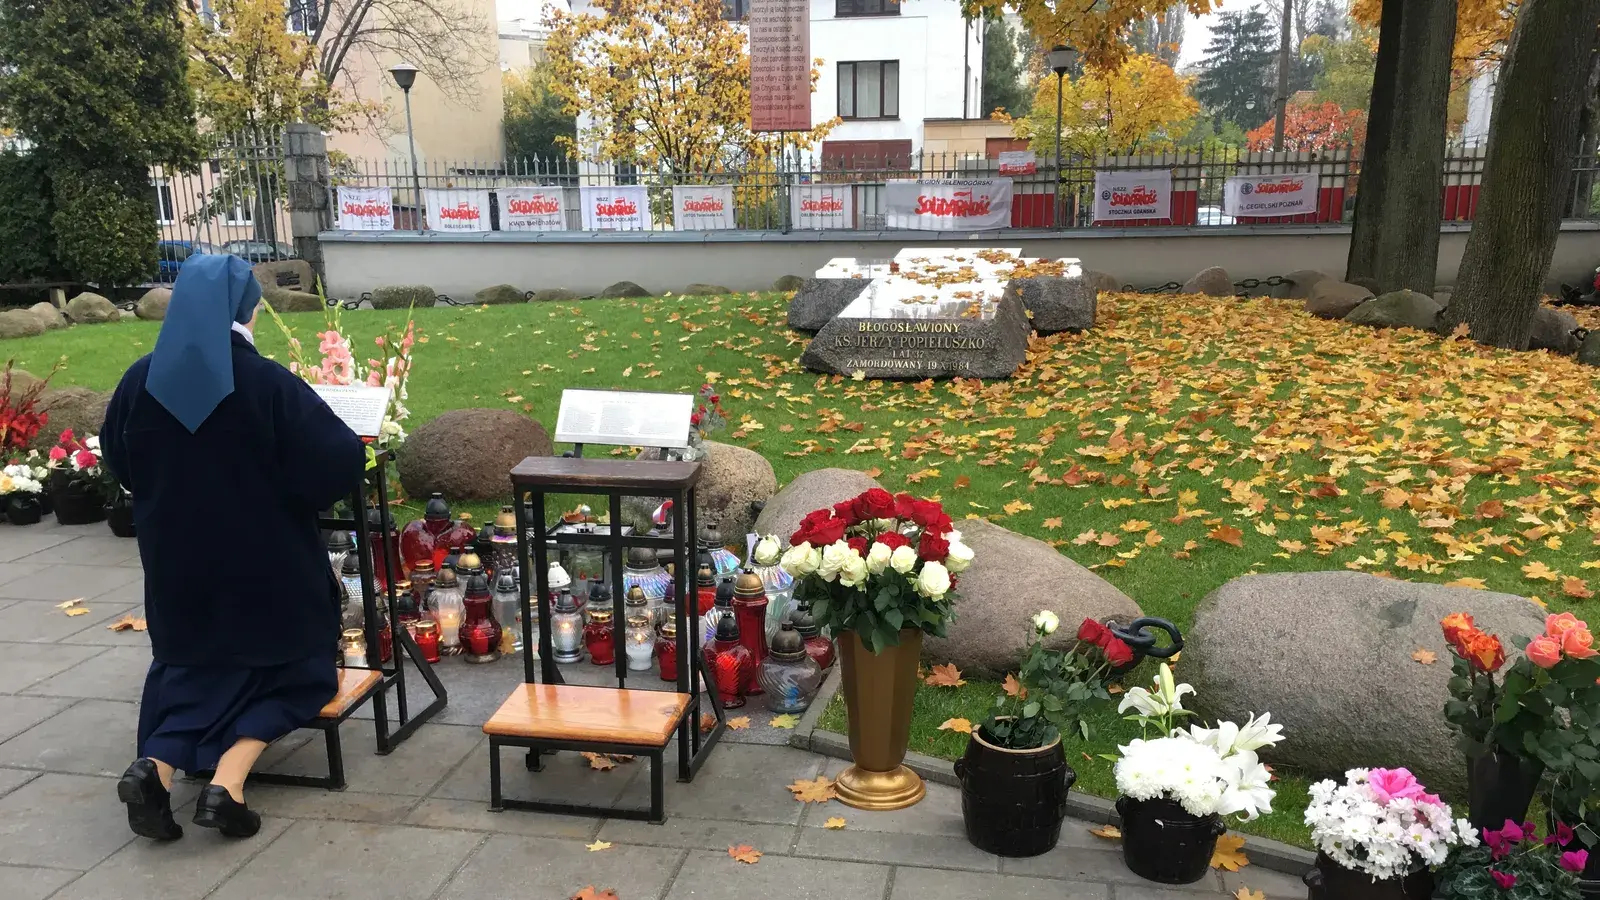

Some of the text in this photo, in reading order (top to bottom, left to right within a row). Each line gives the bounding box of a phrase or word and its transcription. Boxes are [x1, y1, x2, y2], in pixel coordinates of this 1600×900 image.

[1246, 202, 1278, 210] CEGIELSKI
[858, 321, 961, 334] BŁOGOSŁAWIONY
[835, 335, 985, 350] KS. JERZY POPIEŁUSZKO
[846, 359, 924, 370] ZAMORDOWANY
